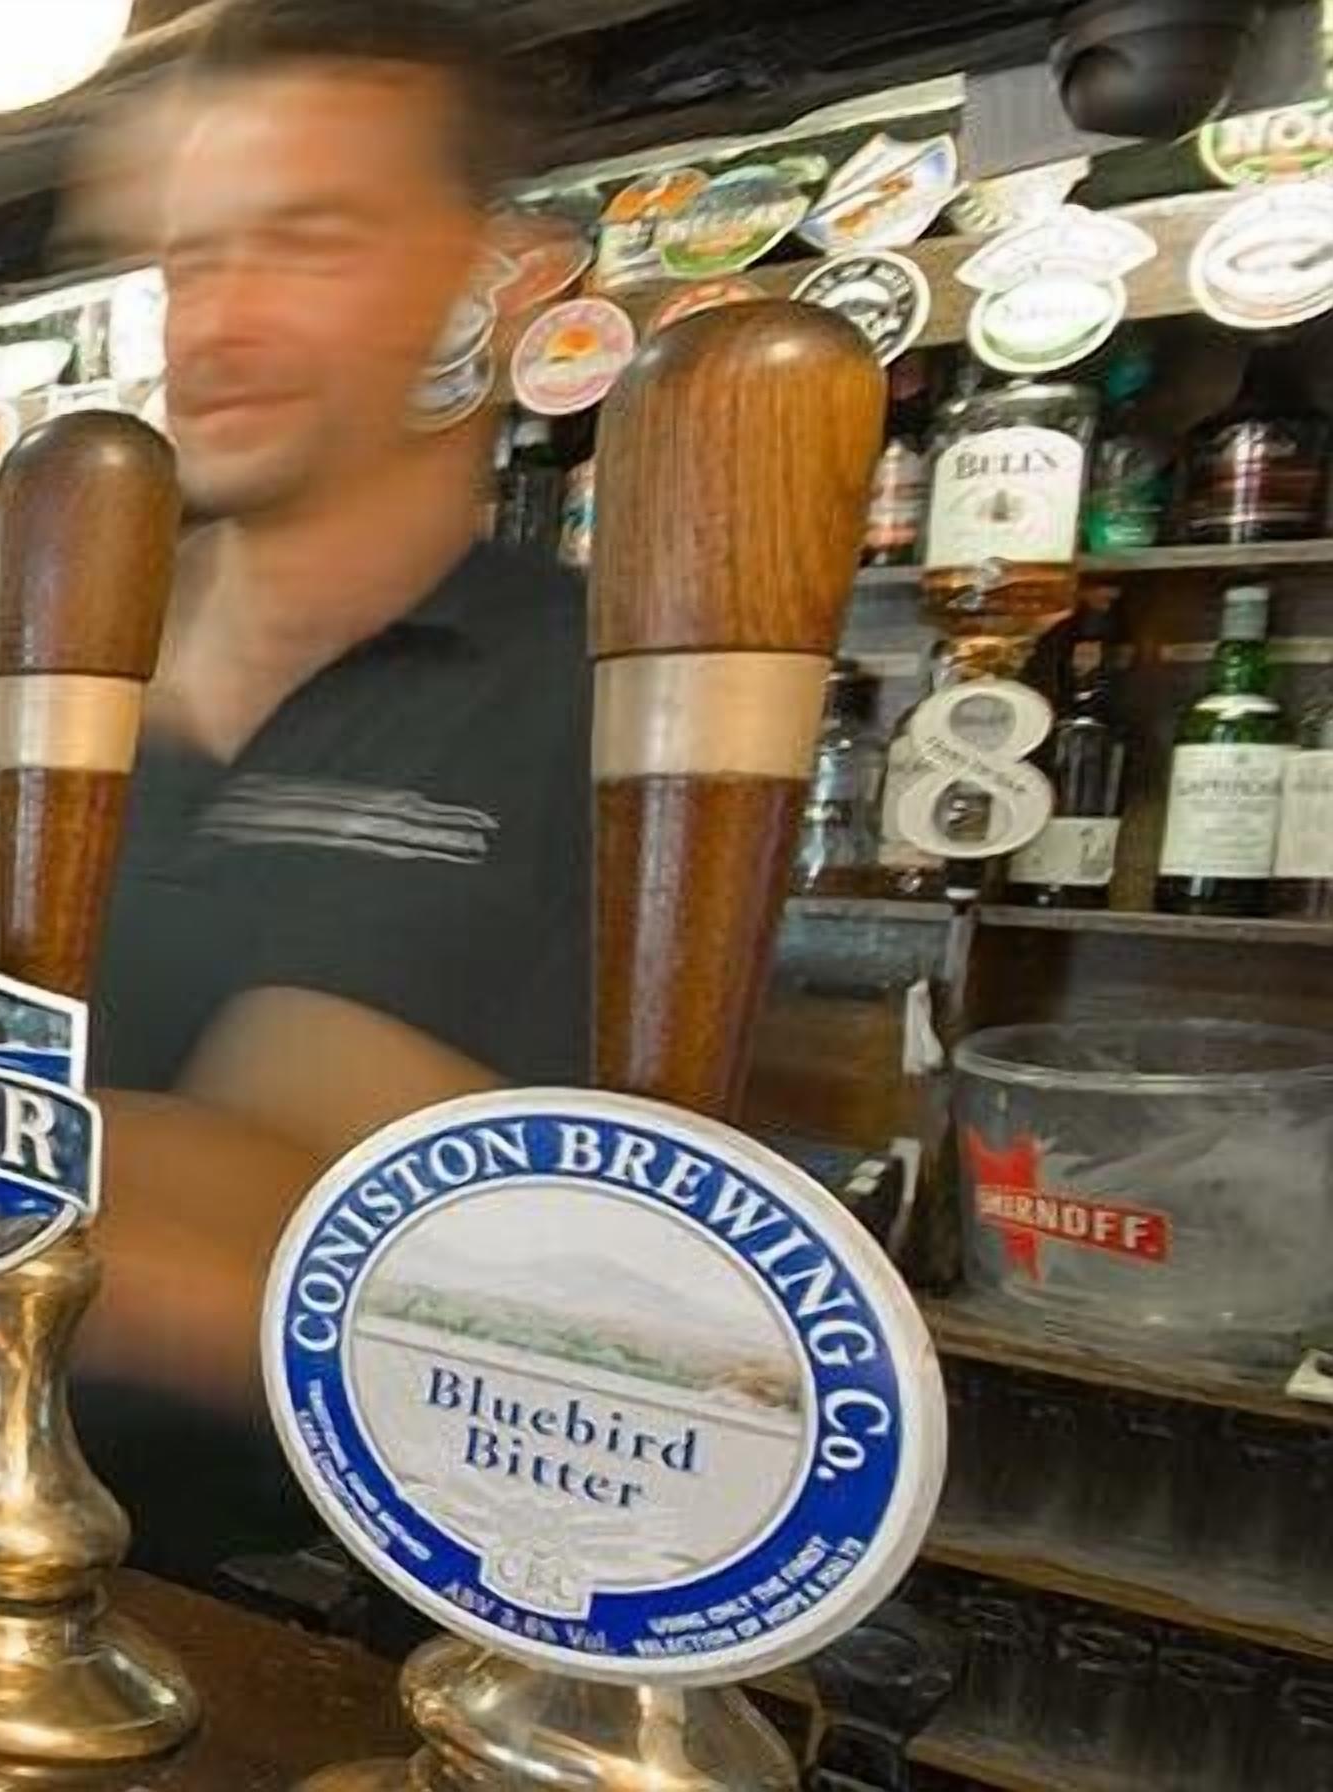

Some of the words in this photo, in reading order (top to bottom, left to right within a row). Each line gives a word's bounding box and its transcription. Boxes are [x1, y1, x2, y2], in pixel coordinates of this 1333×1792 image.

[290, 1120, 533, 1353] CONISTON
[558, 1121, 877, 1369] BREWING
[816, 1387, 891, 1482] Co.
[428, 1366, 699, 1474] Bluebird
[465, 1426, 645, 1509] Bitter
